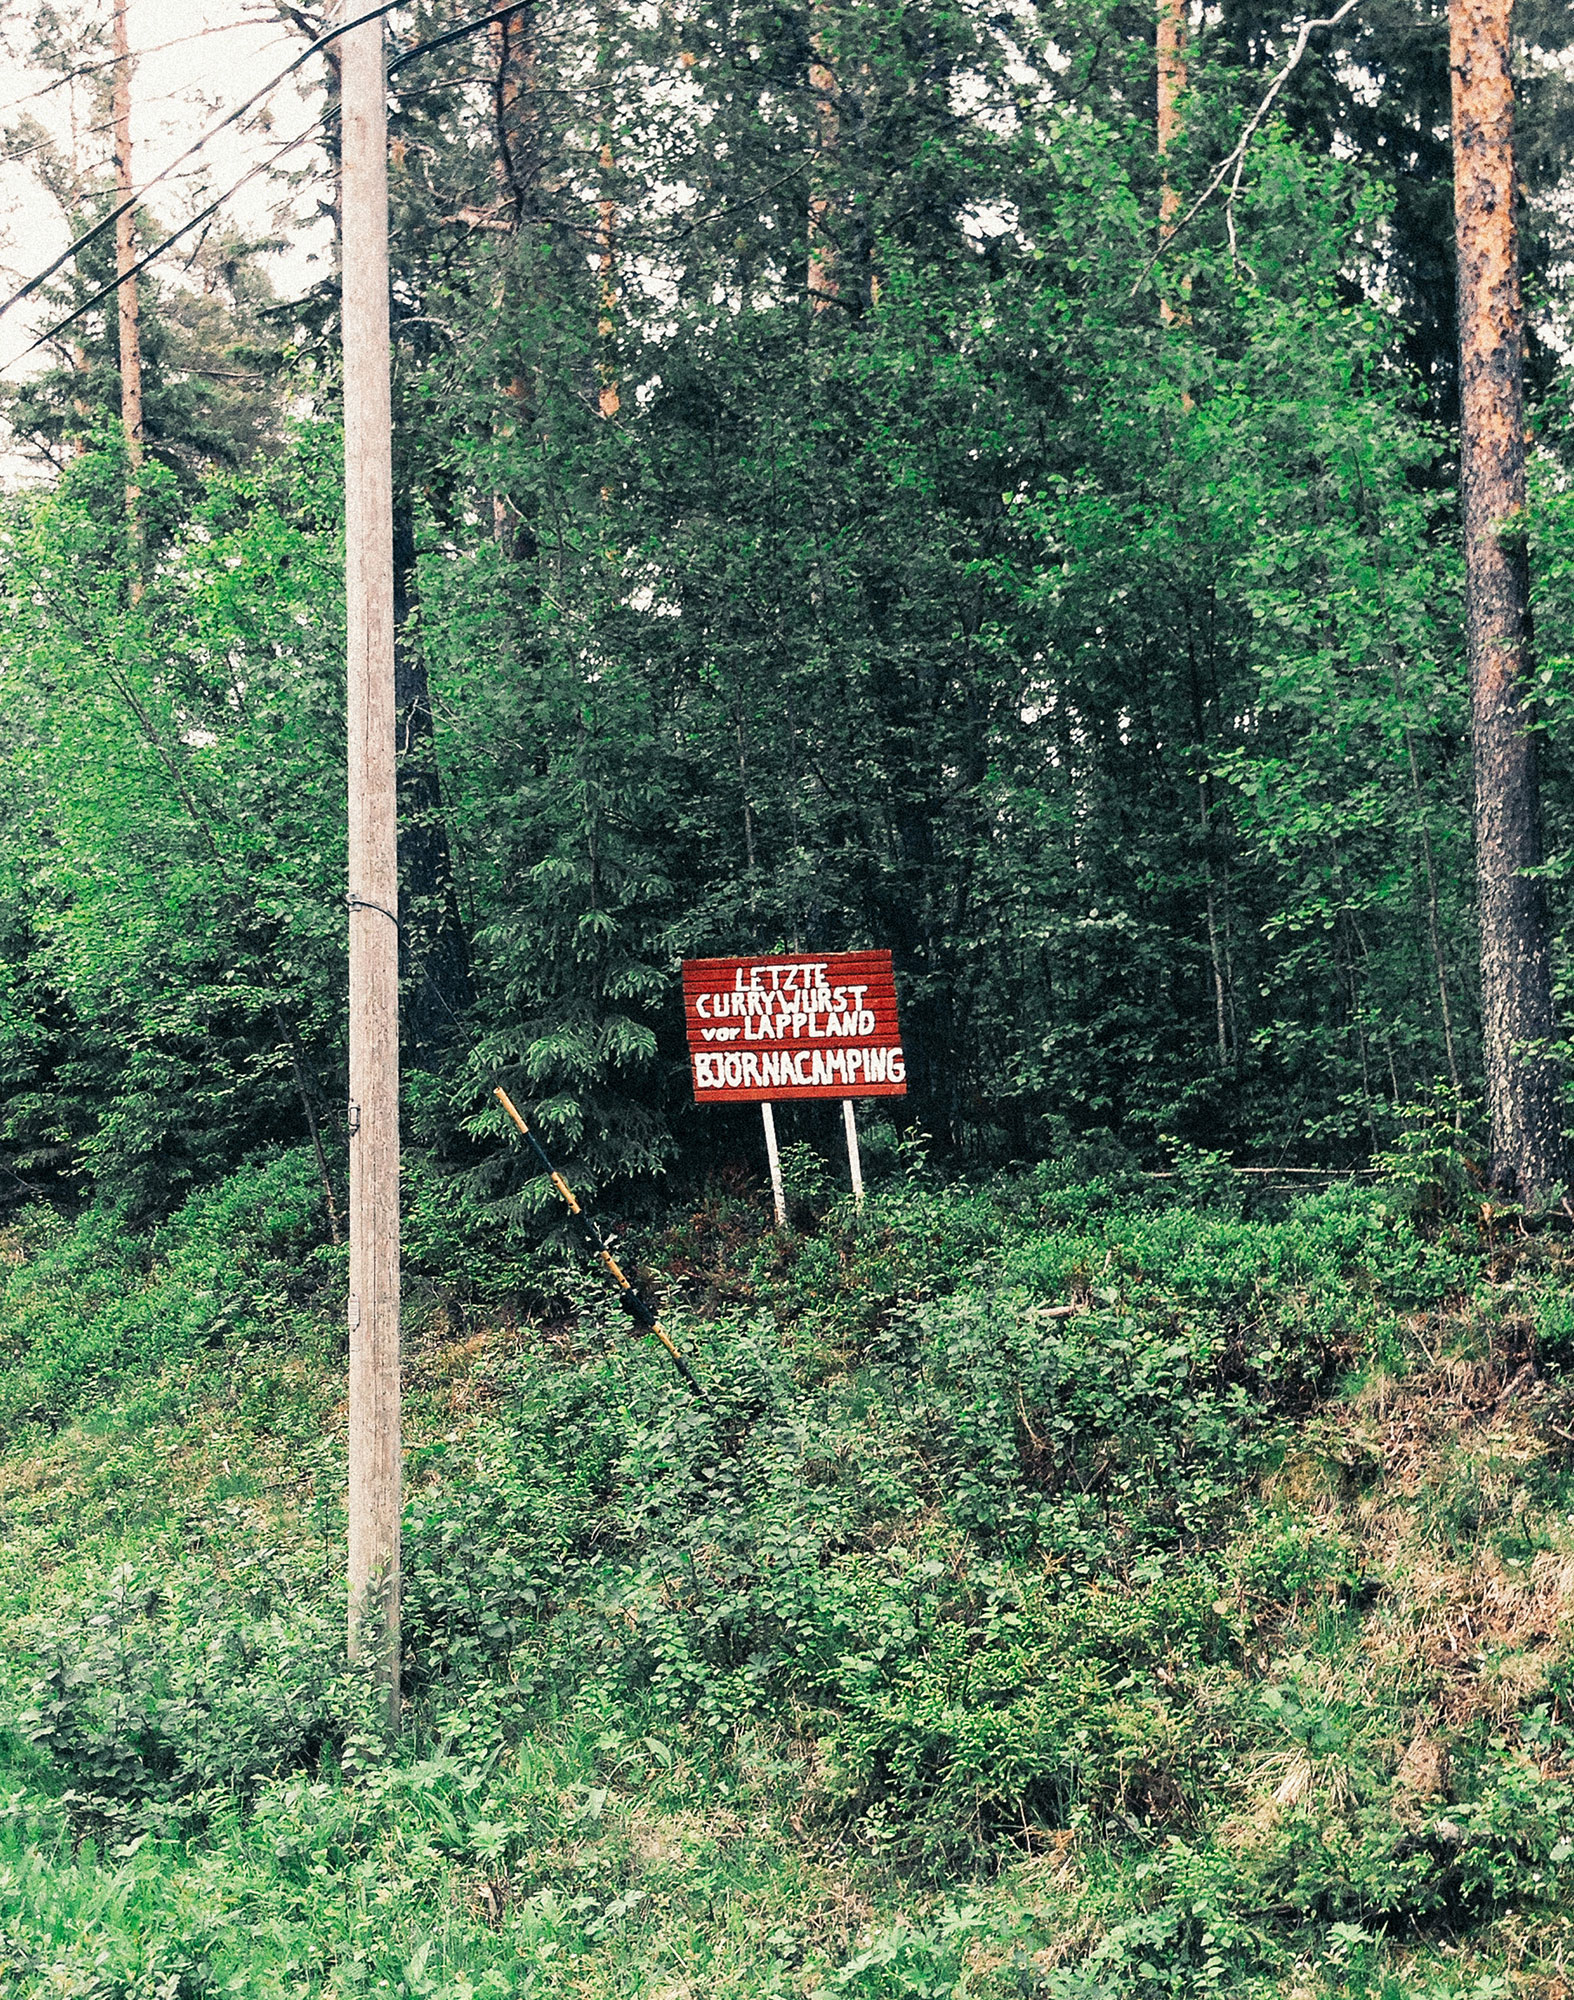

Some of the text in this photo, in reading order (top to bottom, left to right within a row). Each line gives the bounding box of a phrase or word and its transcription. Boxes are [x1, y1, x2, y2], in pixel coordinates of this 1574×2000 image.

[735, 963, 829, 992] LETZTE
[696, 985, 868, 1018] CURRYWURST
[700, 1010, 875, 1042] vor LAPPLAND
[694, 1047, 906, 1088] BJÖRNACAMPING
